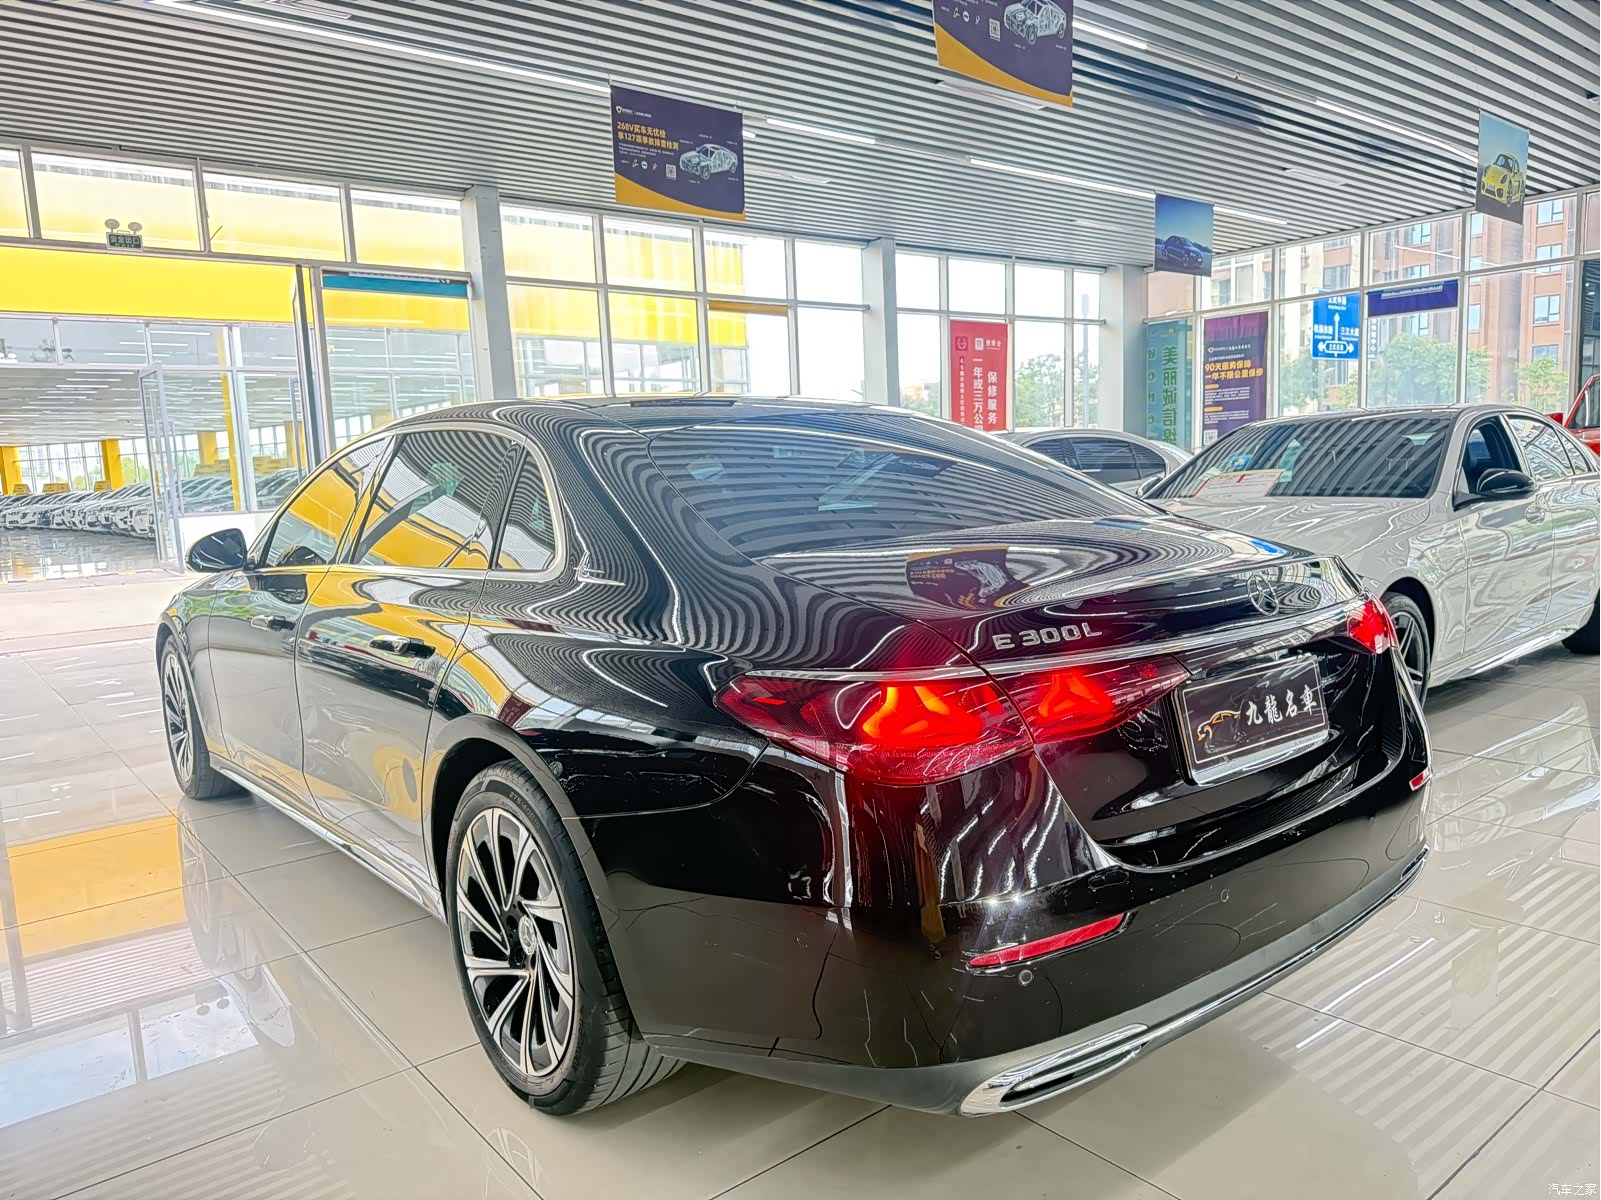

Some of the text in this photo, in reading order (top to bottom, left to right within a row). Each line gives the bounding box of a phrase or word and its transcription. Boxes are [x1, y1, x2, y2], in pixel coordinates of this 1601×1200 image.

[987, 371, 998, 424] 保修服务
[992, 622, 1102, 650] E 300L
